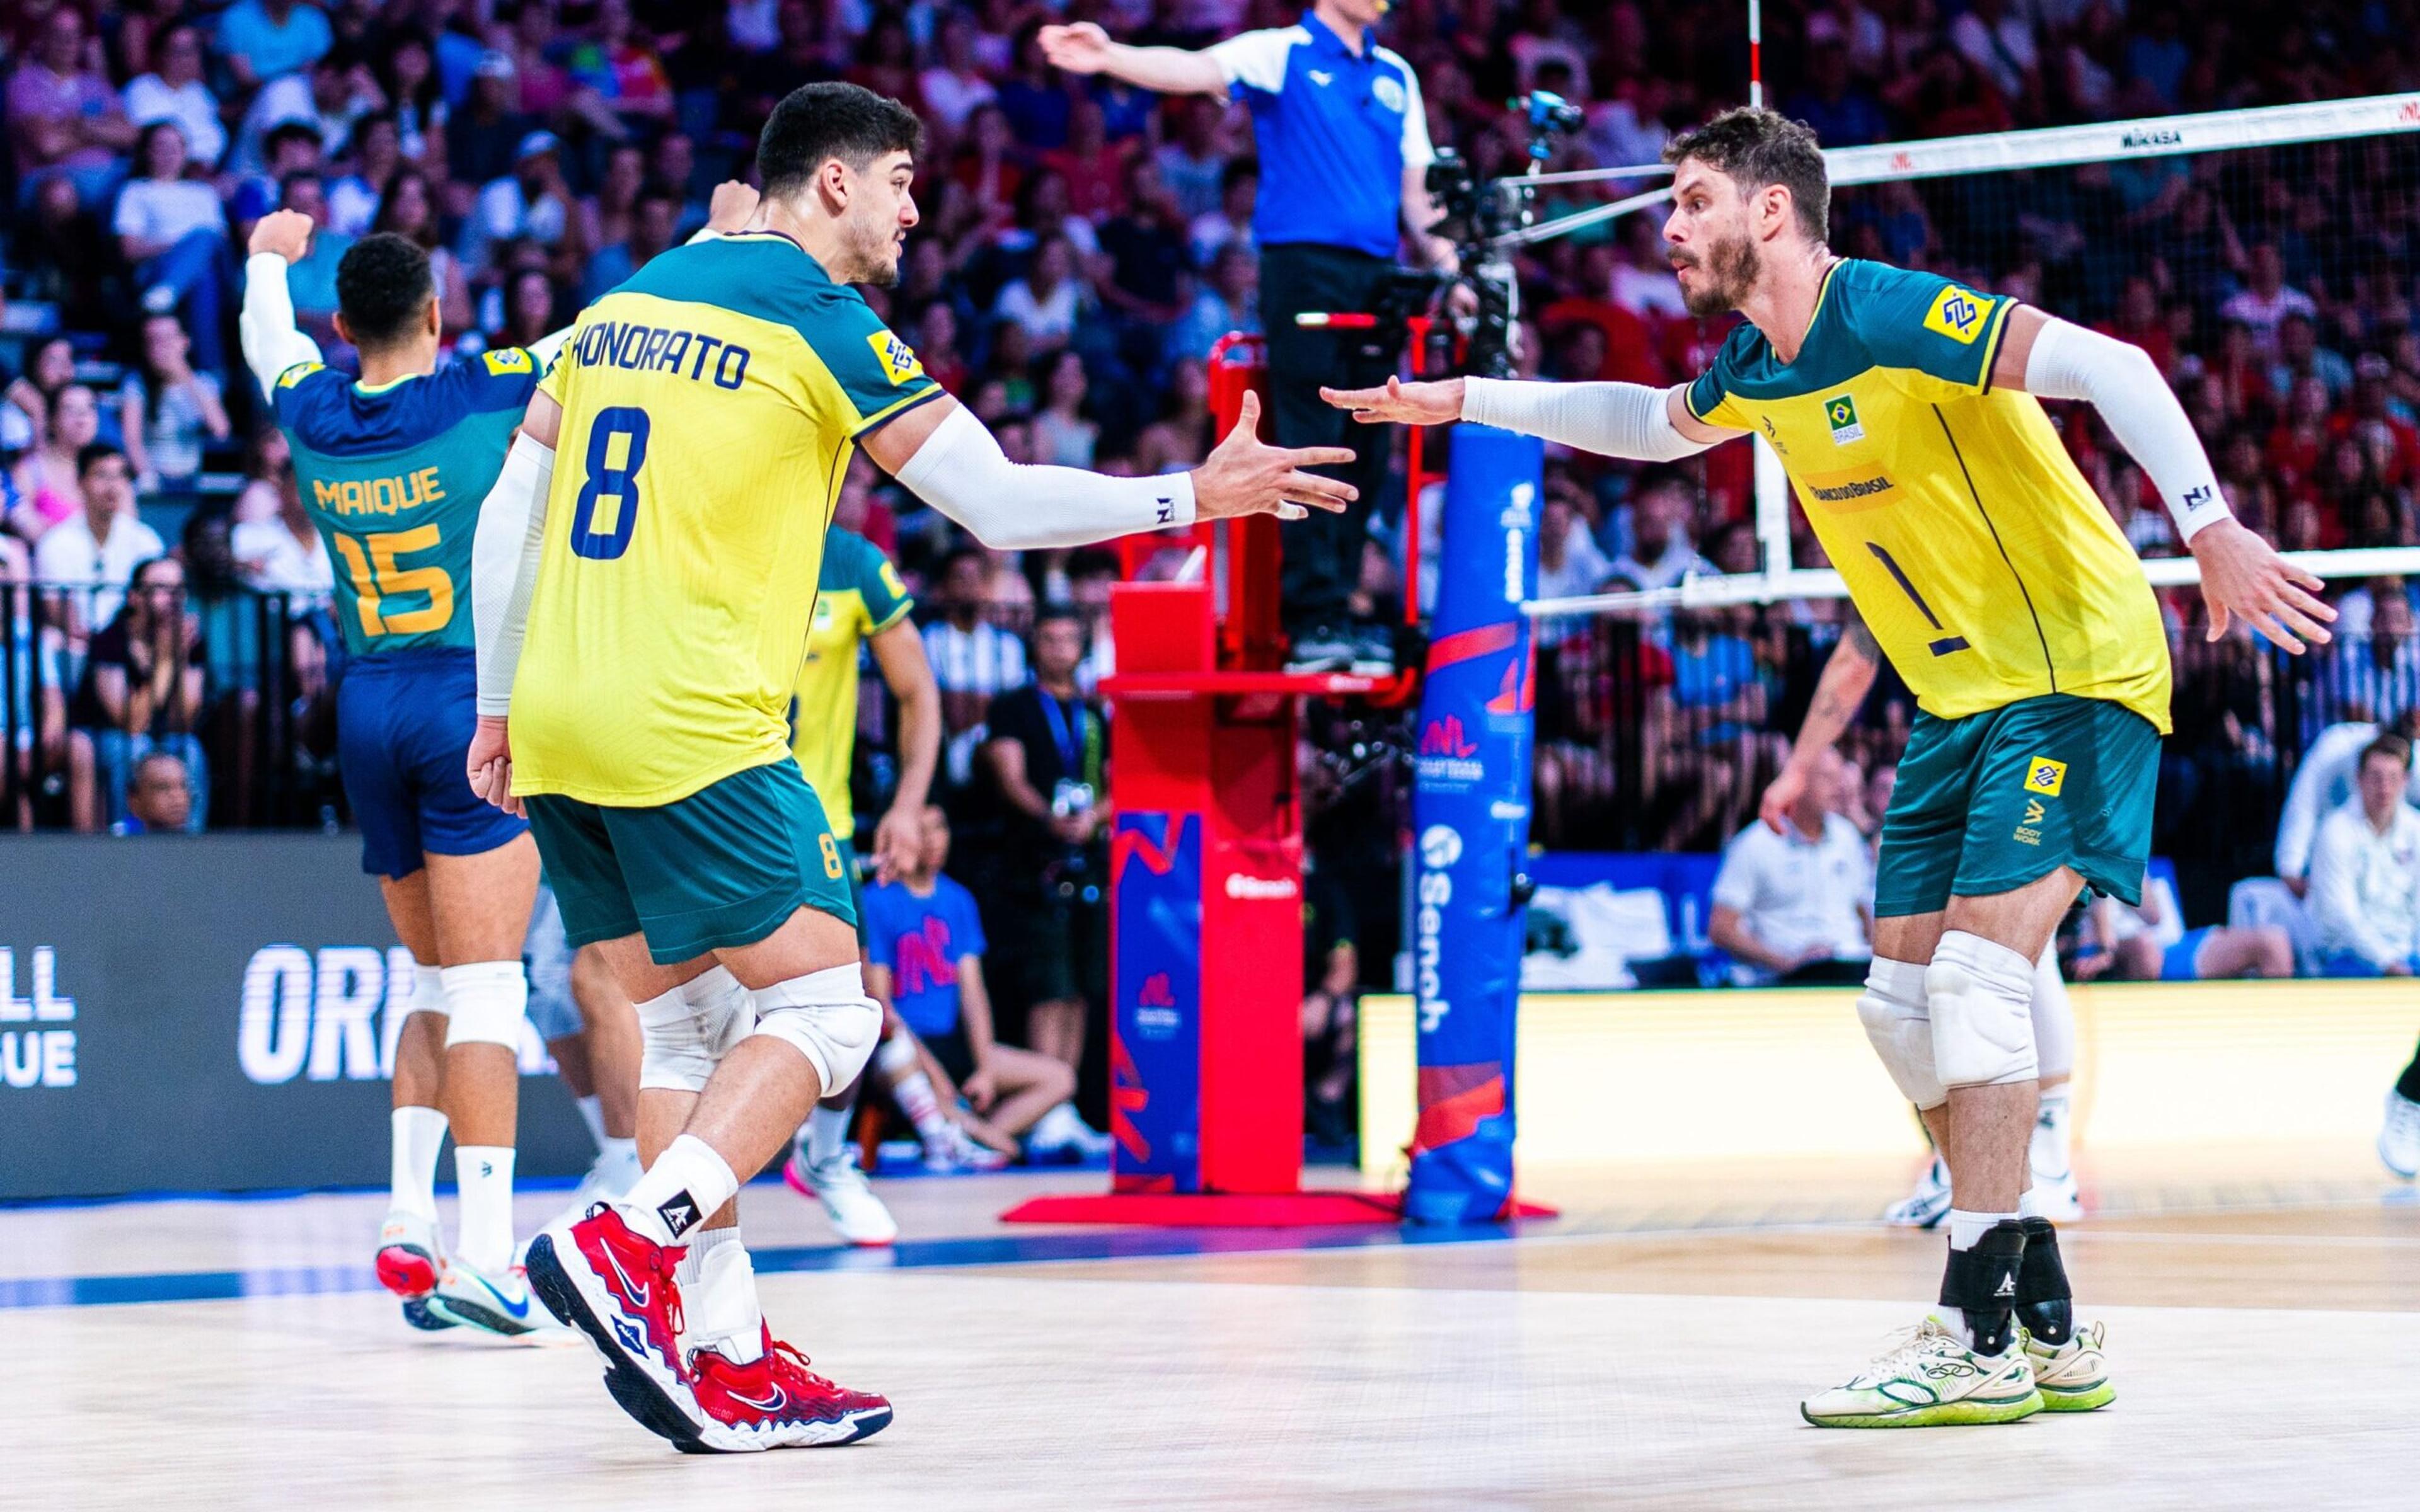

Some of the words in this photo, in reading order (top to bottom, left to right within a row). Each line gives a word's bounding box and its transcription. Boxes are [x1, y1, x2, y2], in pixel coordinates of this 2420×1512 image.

[571, 321, 751, 391] HONORATO
[1833, 426, 1864, 443] BRASIL
[313, 466, 446, 515] MAIQUE
[570, 406, 650, 560] 8
[333, 523, 454, 637] 15
[1865, 541, 1971, 656] 1
[818, 833, 843, 878] 8
[2013, 833, 2041, 846] WORK
[2016, 826, 2042, 838] BODY
